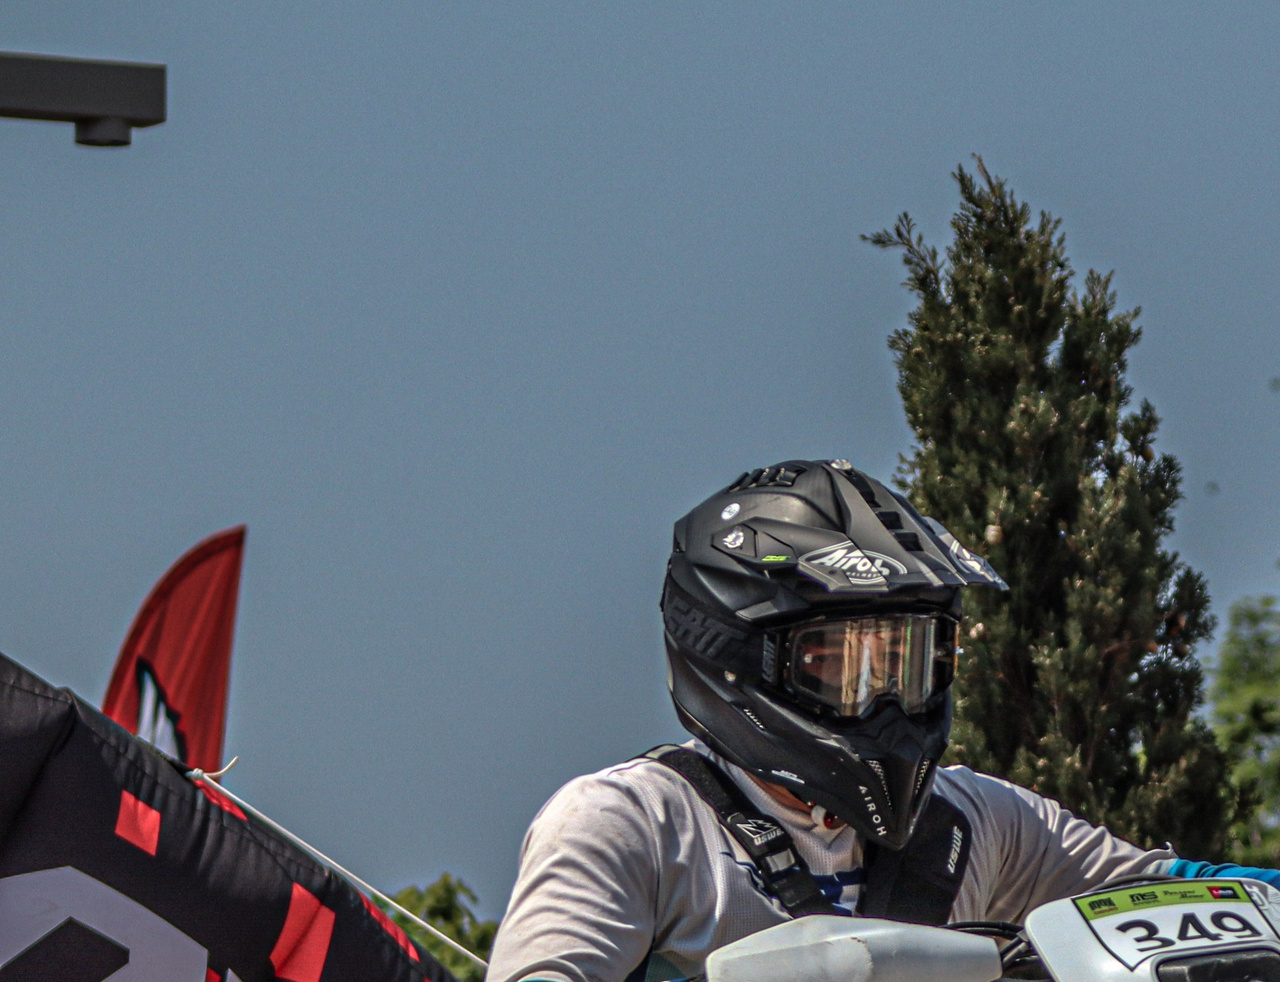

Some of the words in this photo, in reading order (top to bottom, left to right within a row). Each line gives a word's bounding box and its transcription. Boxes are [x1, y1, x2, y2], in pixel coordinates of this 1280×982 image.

[810, 549, 891, 576] Airoh
[858, 785, 887, 837] AIROH
[753, 830, 785, 846] USWE
[947, 825, 963, 874] USWE
[1115, 910, 1263, 952] 349
